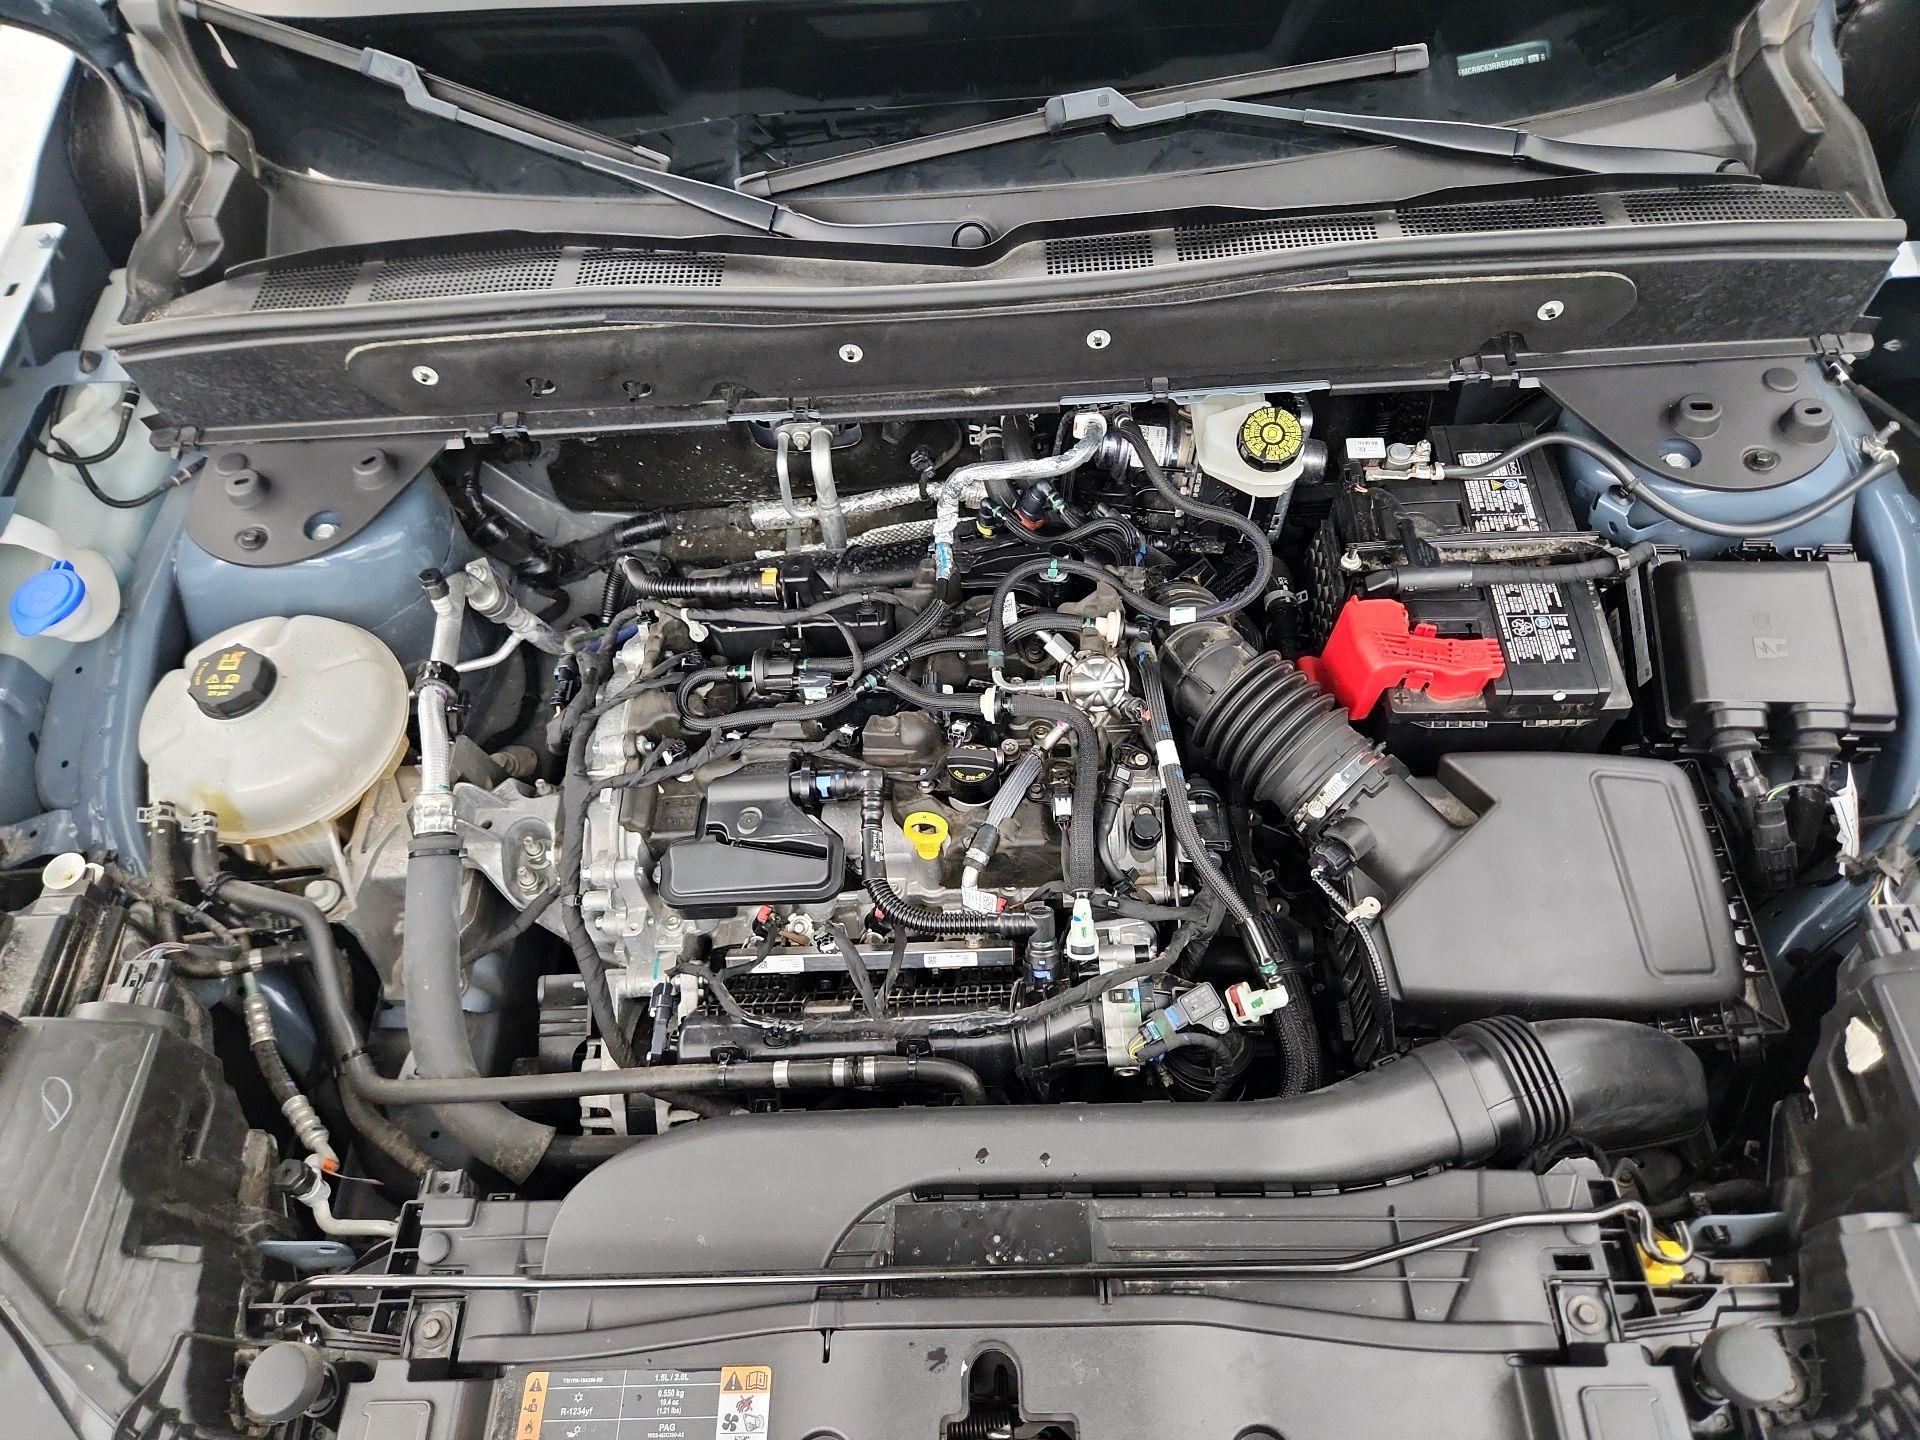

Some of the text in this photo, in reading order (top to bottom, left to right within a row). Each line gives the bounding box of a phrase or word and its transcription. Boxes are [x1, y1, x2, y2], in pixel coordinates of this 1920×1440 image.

[655, 1373, 670, 1382] 1.5L
[674, 1372, 690, 1381] 2.0L
[657, 1388, 684, 1399] 0.550 kg
[560, 1406, 594, 1417] R-1234yf
[658, 1423, 676, 1432] PAG
